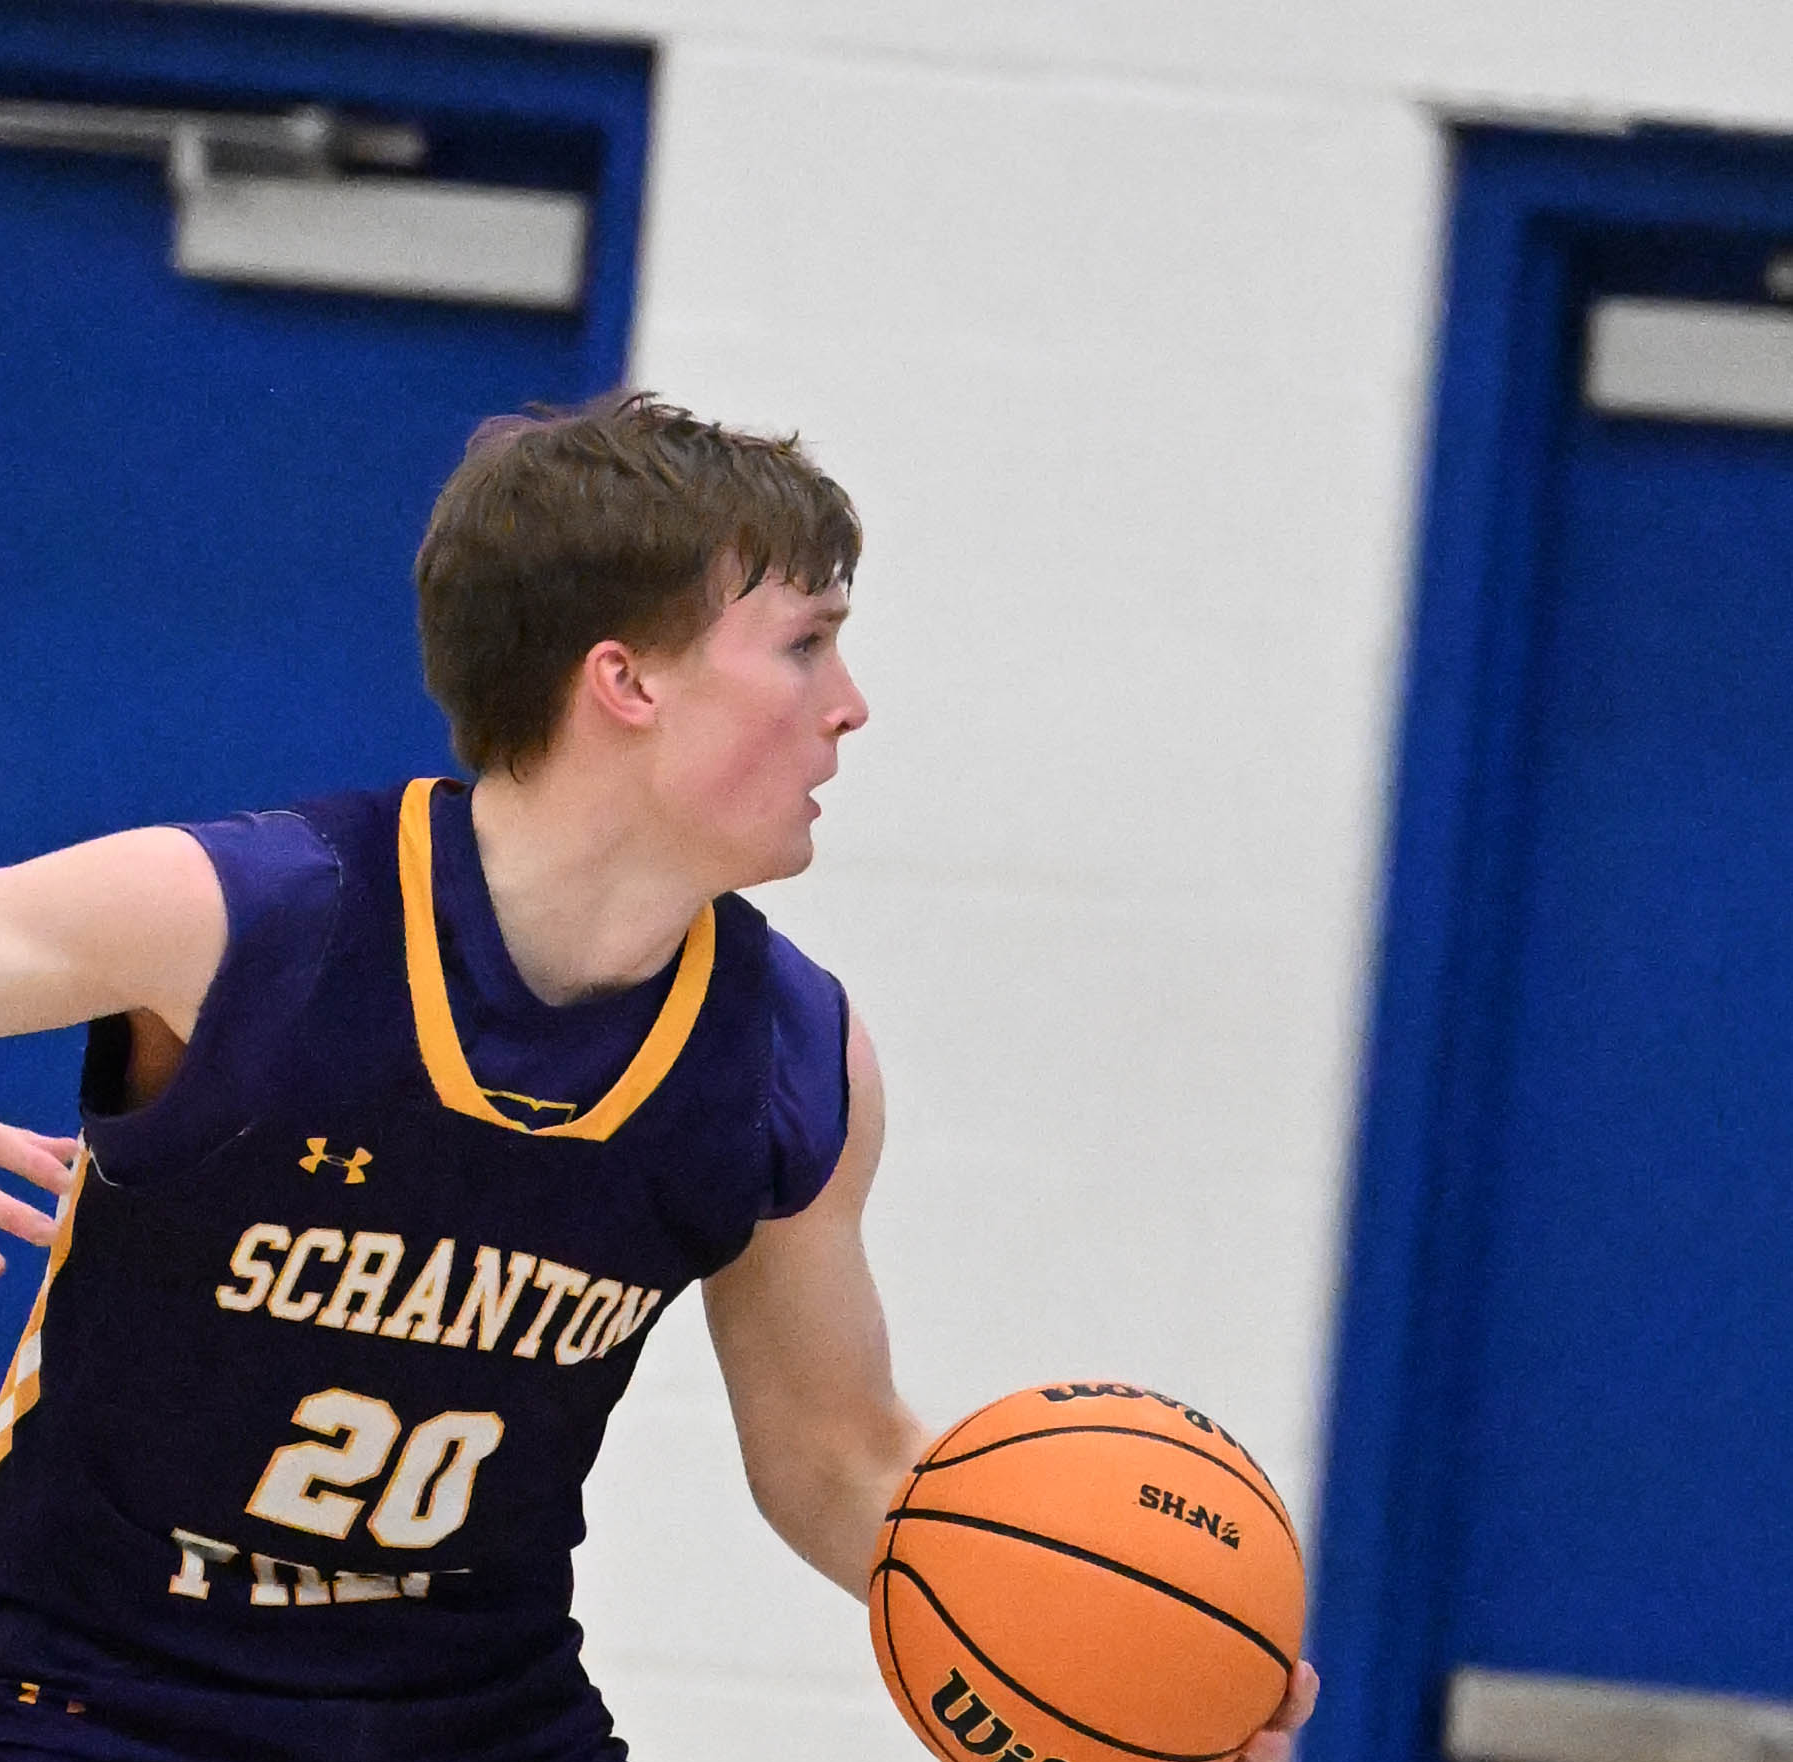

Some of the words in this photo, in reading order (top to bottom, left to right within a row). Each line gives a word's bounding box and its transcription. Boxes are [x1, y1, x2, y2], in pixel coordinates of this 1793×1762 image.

[215, 1222, 663, 1366] SCRANTON
[244, 1386, 506, 1549] 20
[1138, 1483, 1223, 1540] NFHS
